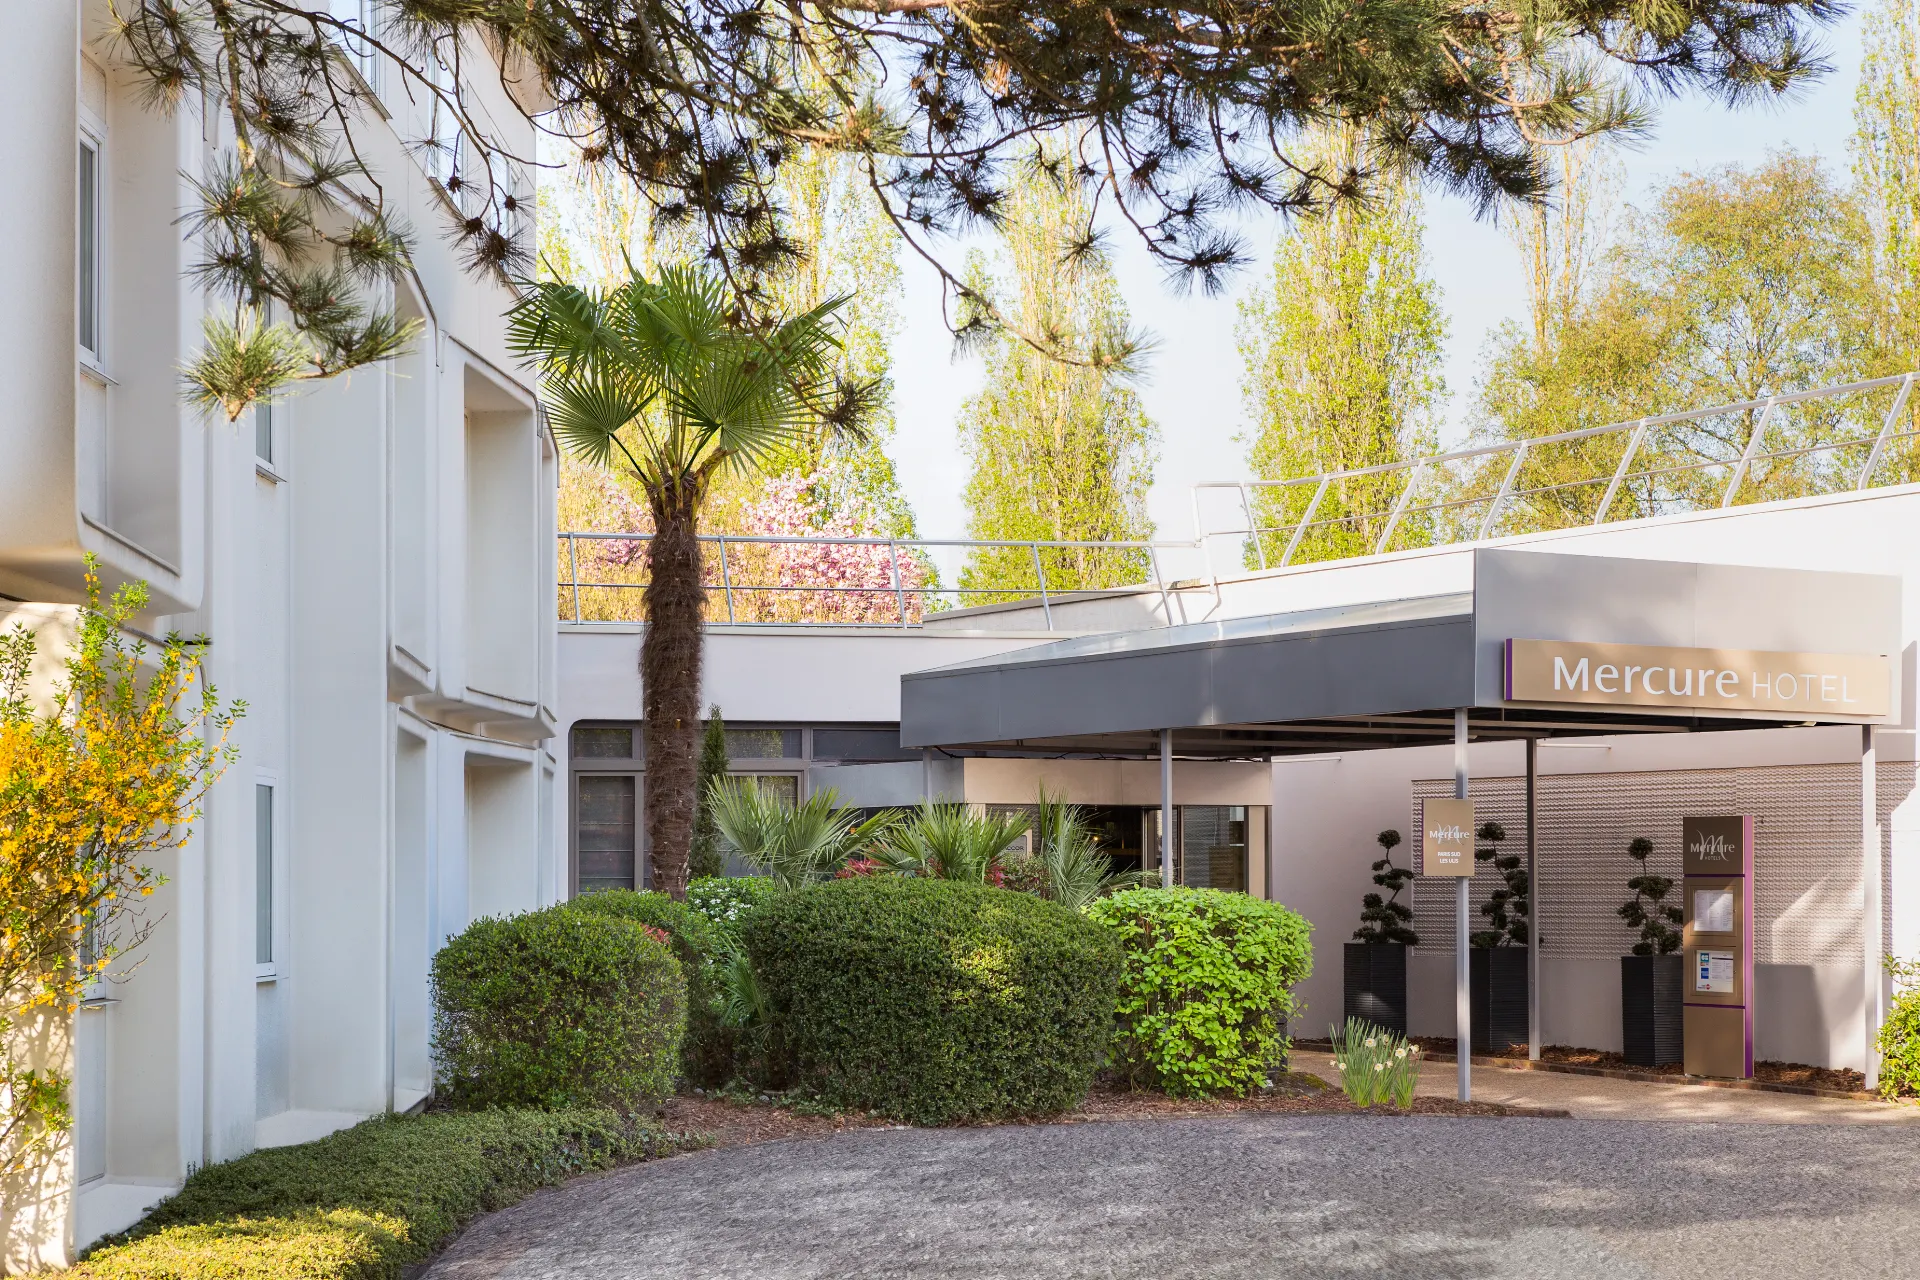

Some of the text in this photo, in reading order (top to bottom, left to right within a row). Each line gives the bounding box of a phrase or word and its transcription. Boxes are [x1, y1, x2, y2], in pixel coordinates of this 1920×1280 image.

[1554, 656, 1858, 703] Mercure HOTEL
[1429, 830, 1469, 839] Mercure
[1690, 842, 1735, 853] Mercure
